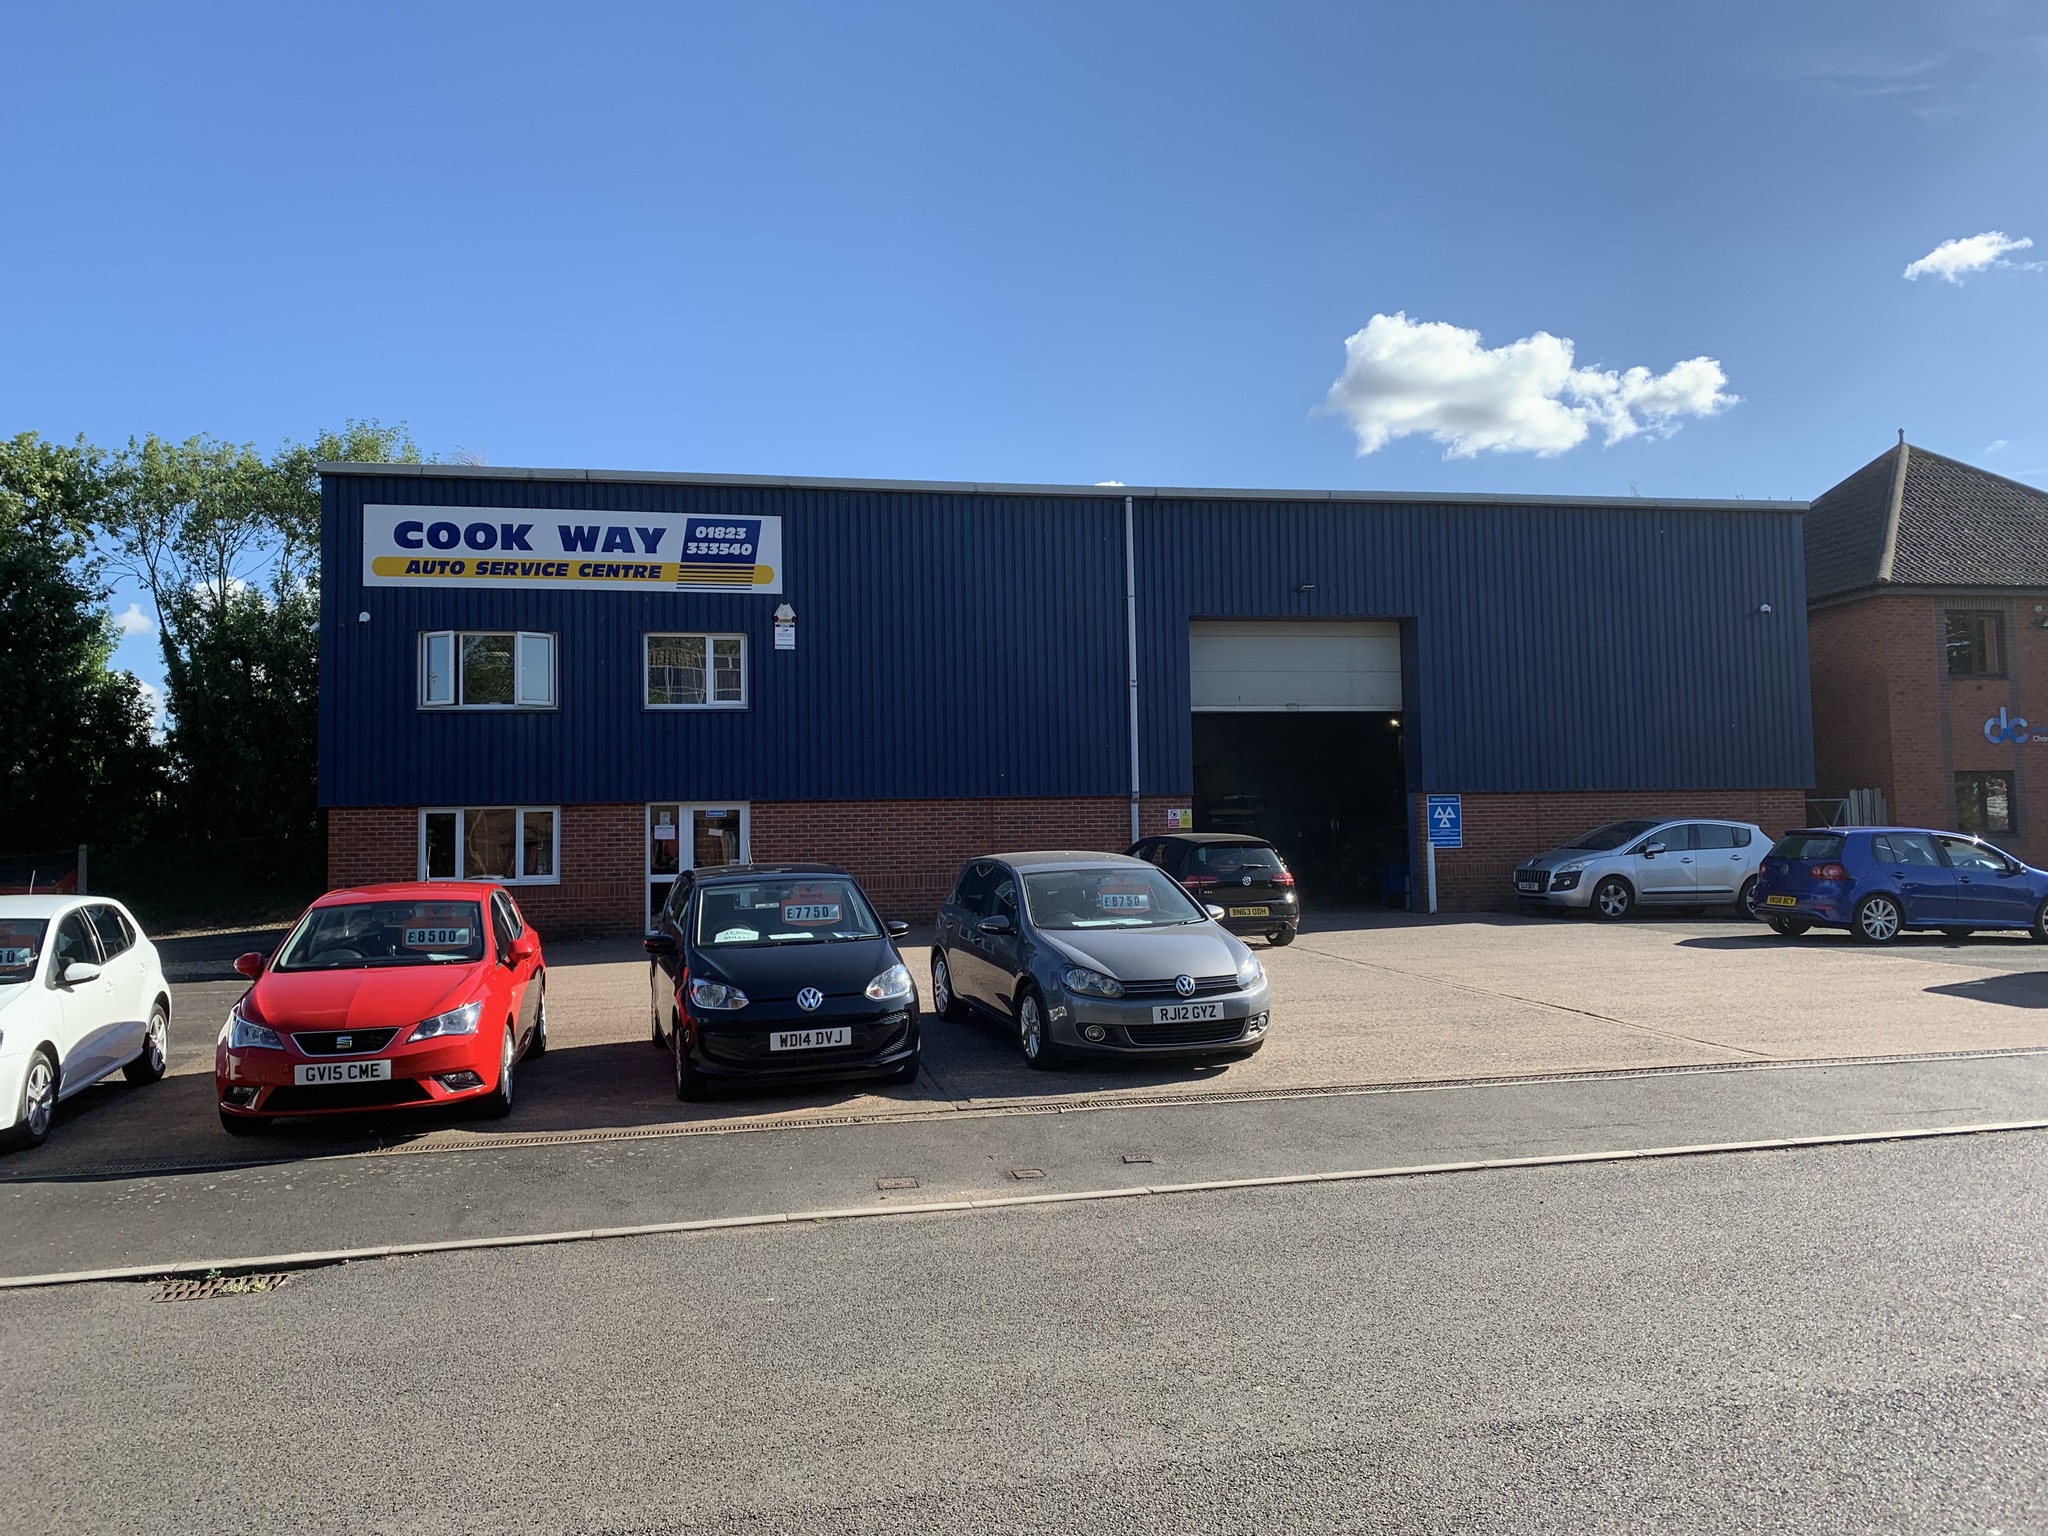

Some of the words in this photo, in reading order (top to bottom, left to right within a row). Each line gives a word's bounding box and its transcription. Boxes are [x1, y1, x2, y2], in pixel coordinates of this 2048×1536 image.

[393, 520, 534, 551] COOK
[557, 524, 668, 554] WAY
[695, 526, 747, 539] 01823
[686, 542, 753, 555] 333540
[405, 560, 466, 575] AUTO
[475, 560, 569, 577] SERVICE
[578, 563, 663, 579] CENTRE
[1984, 706, 2028, 744] dc
[1103, 896, 1140, 907] £8750
[786, 906, 829, 919] £7750
[1232, 908, 1251, 916] BN63
[1252, 907, 1267, 915] ODH
[407, 930, 457, 943] £8500
[1160, 1007, 1189, 1021] RJ12
[1192, 1005, 1217, 1019] GYZ
[780, 1032, 811, 1048] WD14
[815, 1030, 843, 1045] DVJ
[305, 1065, 343, 1082] GV15
[347, 1063, 380, 1080] CME
